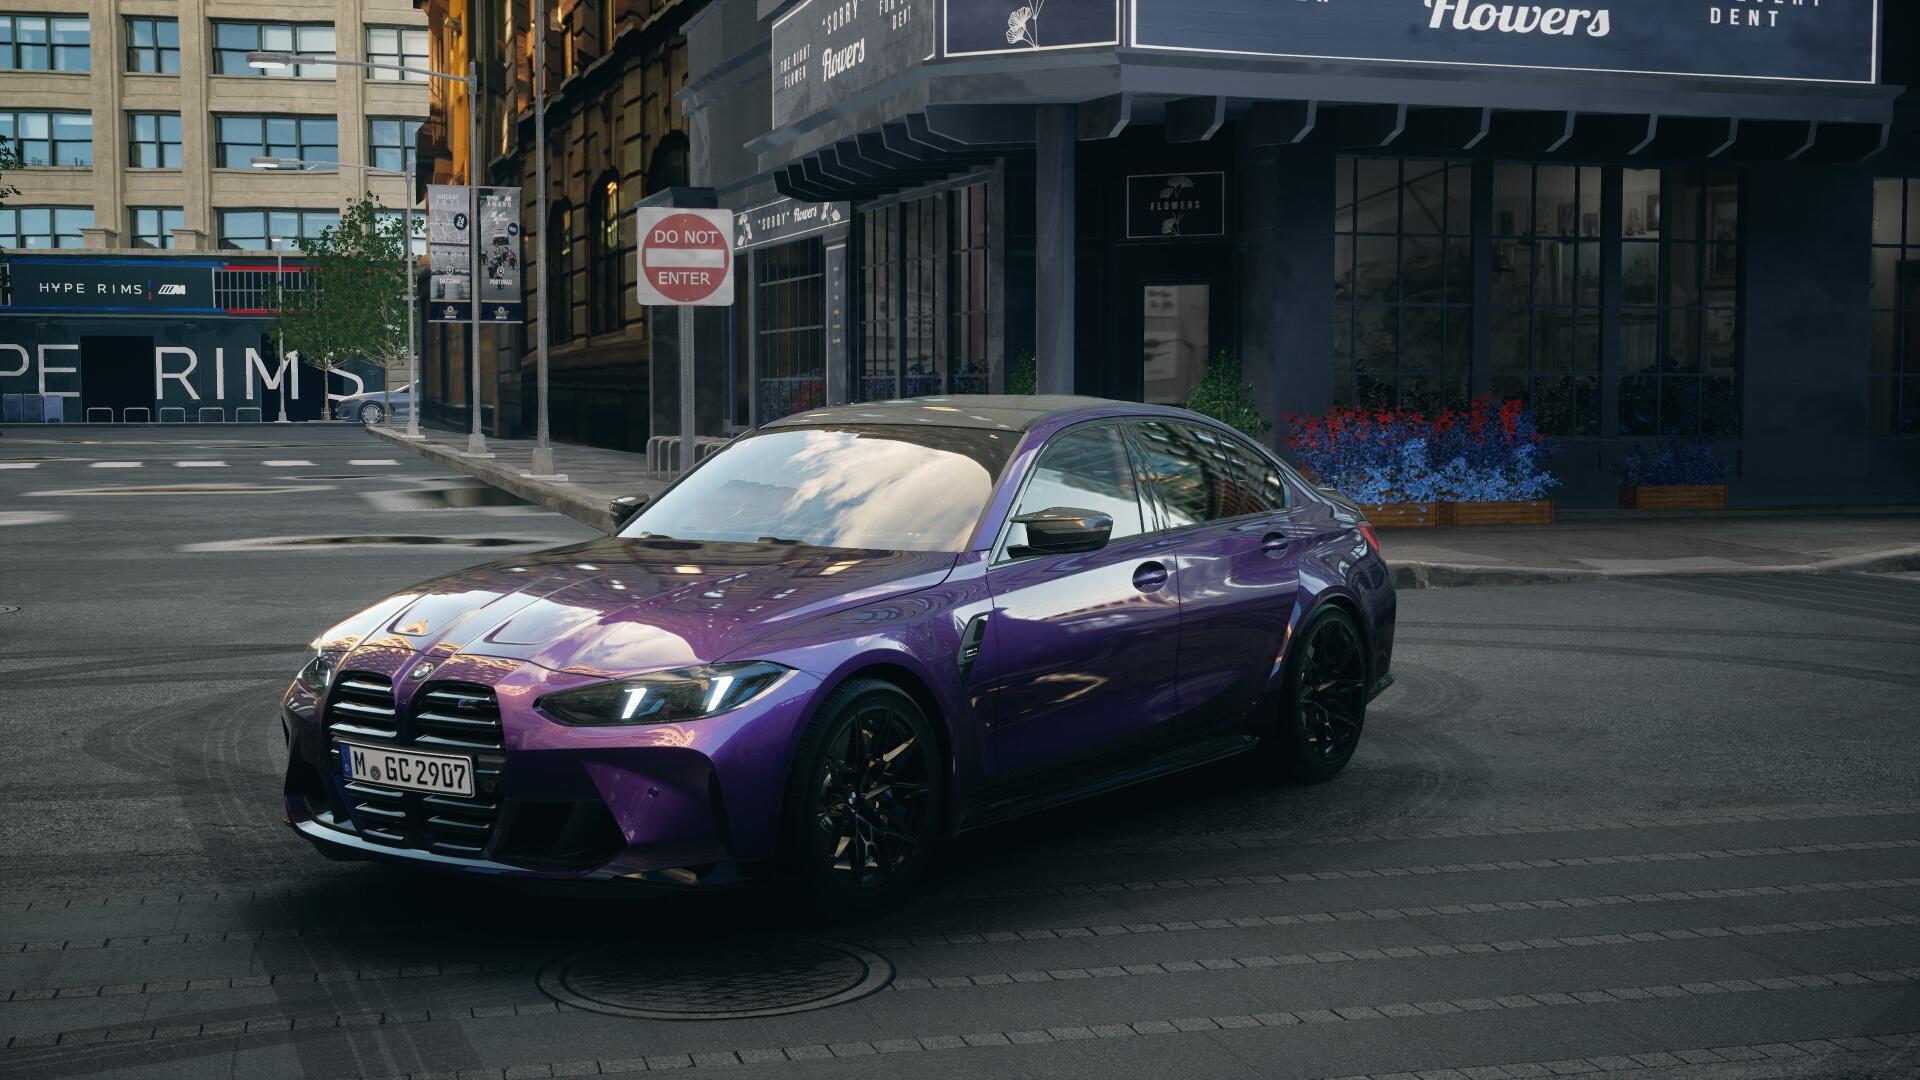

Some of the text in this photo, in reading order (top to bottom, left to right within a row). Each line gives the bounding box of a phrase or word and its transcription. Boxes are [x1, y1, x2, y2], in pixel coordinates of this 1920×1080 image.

[891, 4, 911, 31] DENT
[1710, 7, 1779, 27] DENT
[780, 43, 811, 74] THE RIGHT
[784, 64, 806, 90] FLOWER
[1150, 200, 1201, 211] FLOWERS
[654, 229, 718, 245] DO NOT
[658, 271, 711, 285] ENTER
[39, 282, 86, 294] HYPE
[97, 283, 142, 295] RIMS
[353, 750, 367, 777] M
[384, 756, 412, 783] GC
[415, 760, 466, 789] 2907
